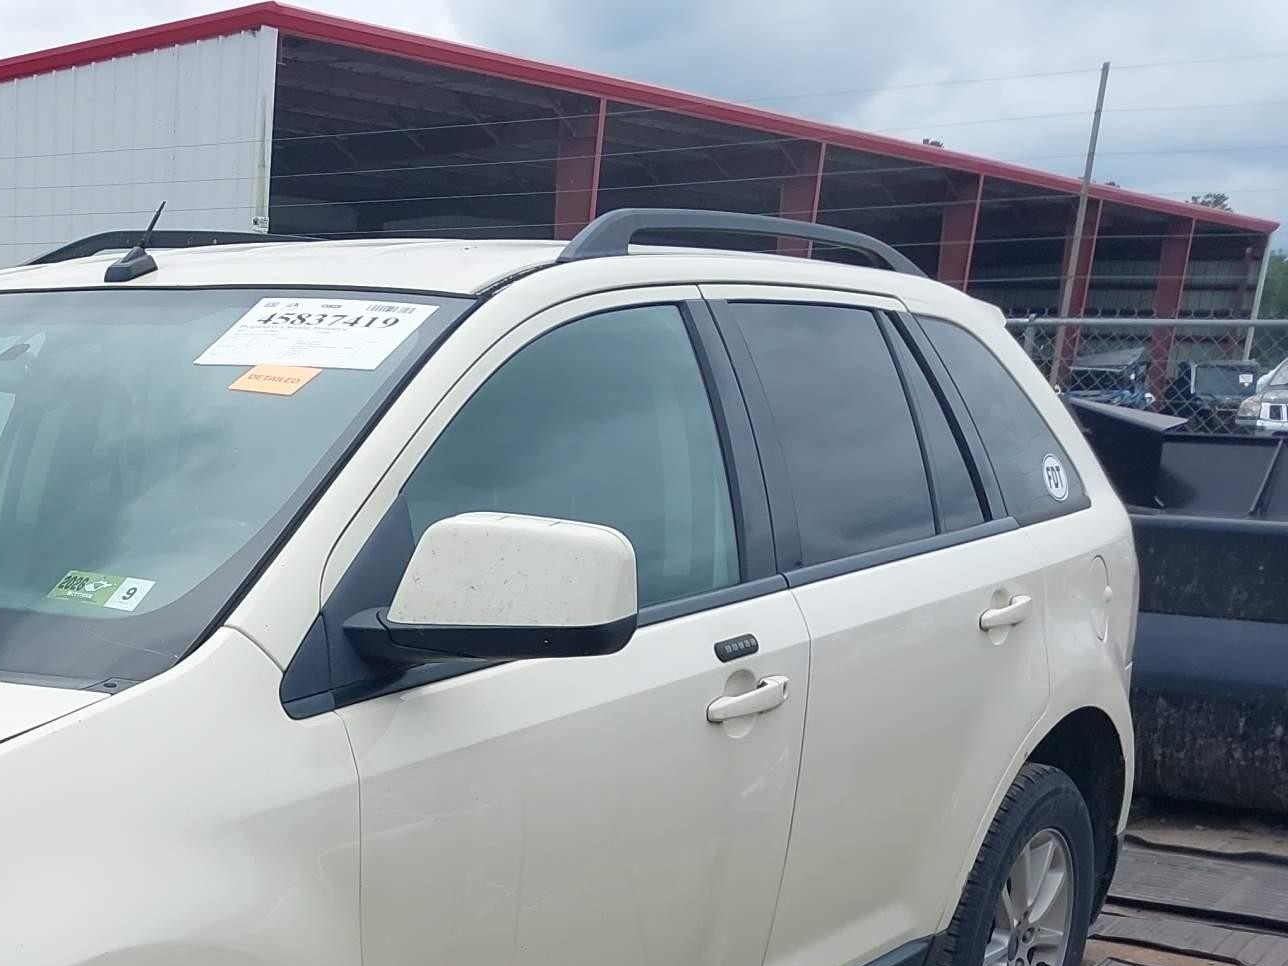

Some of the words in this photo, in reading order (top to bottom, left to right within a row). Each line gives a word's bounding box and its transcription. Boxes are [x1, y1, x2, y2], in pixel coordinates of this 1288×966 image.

[257, 313, 400, 328] 45837419
[248, 374, 302, 384] DETAILED
[1046, 465, 1064, 489] FDT
[123, 587, 137, 601] 9
